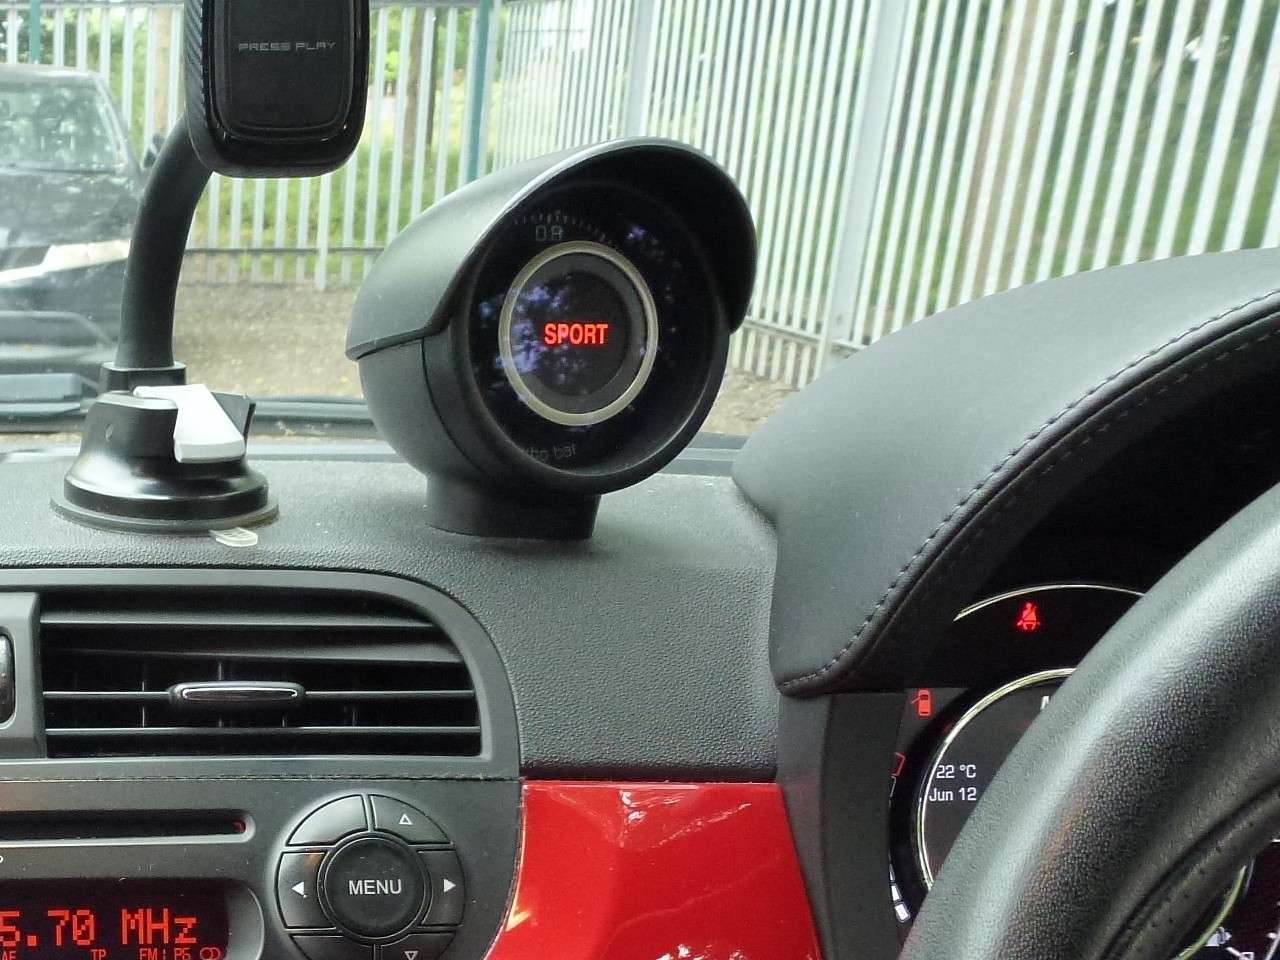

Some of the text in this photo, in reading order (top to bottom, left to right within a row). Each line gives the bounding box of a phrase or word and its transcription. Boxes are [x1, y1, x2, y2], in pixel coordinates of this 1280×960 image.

[238, 41, 337, 52] PRESS PLAY
[544, 322, 609, 345] SPORT
[936, 764, 977, 779] 22 °C
[928, 786, 977, 802] Jun 12
[348, 878, 402, 895] MENU
[121, 908, 197, 945] MHz
